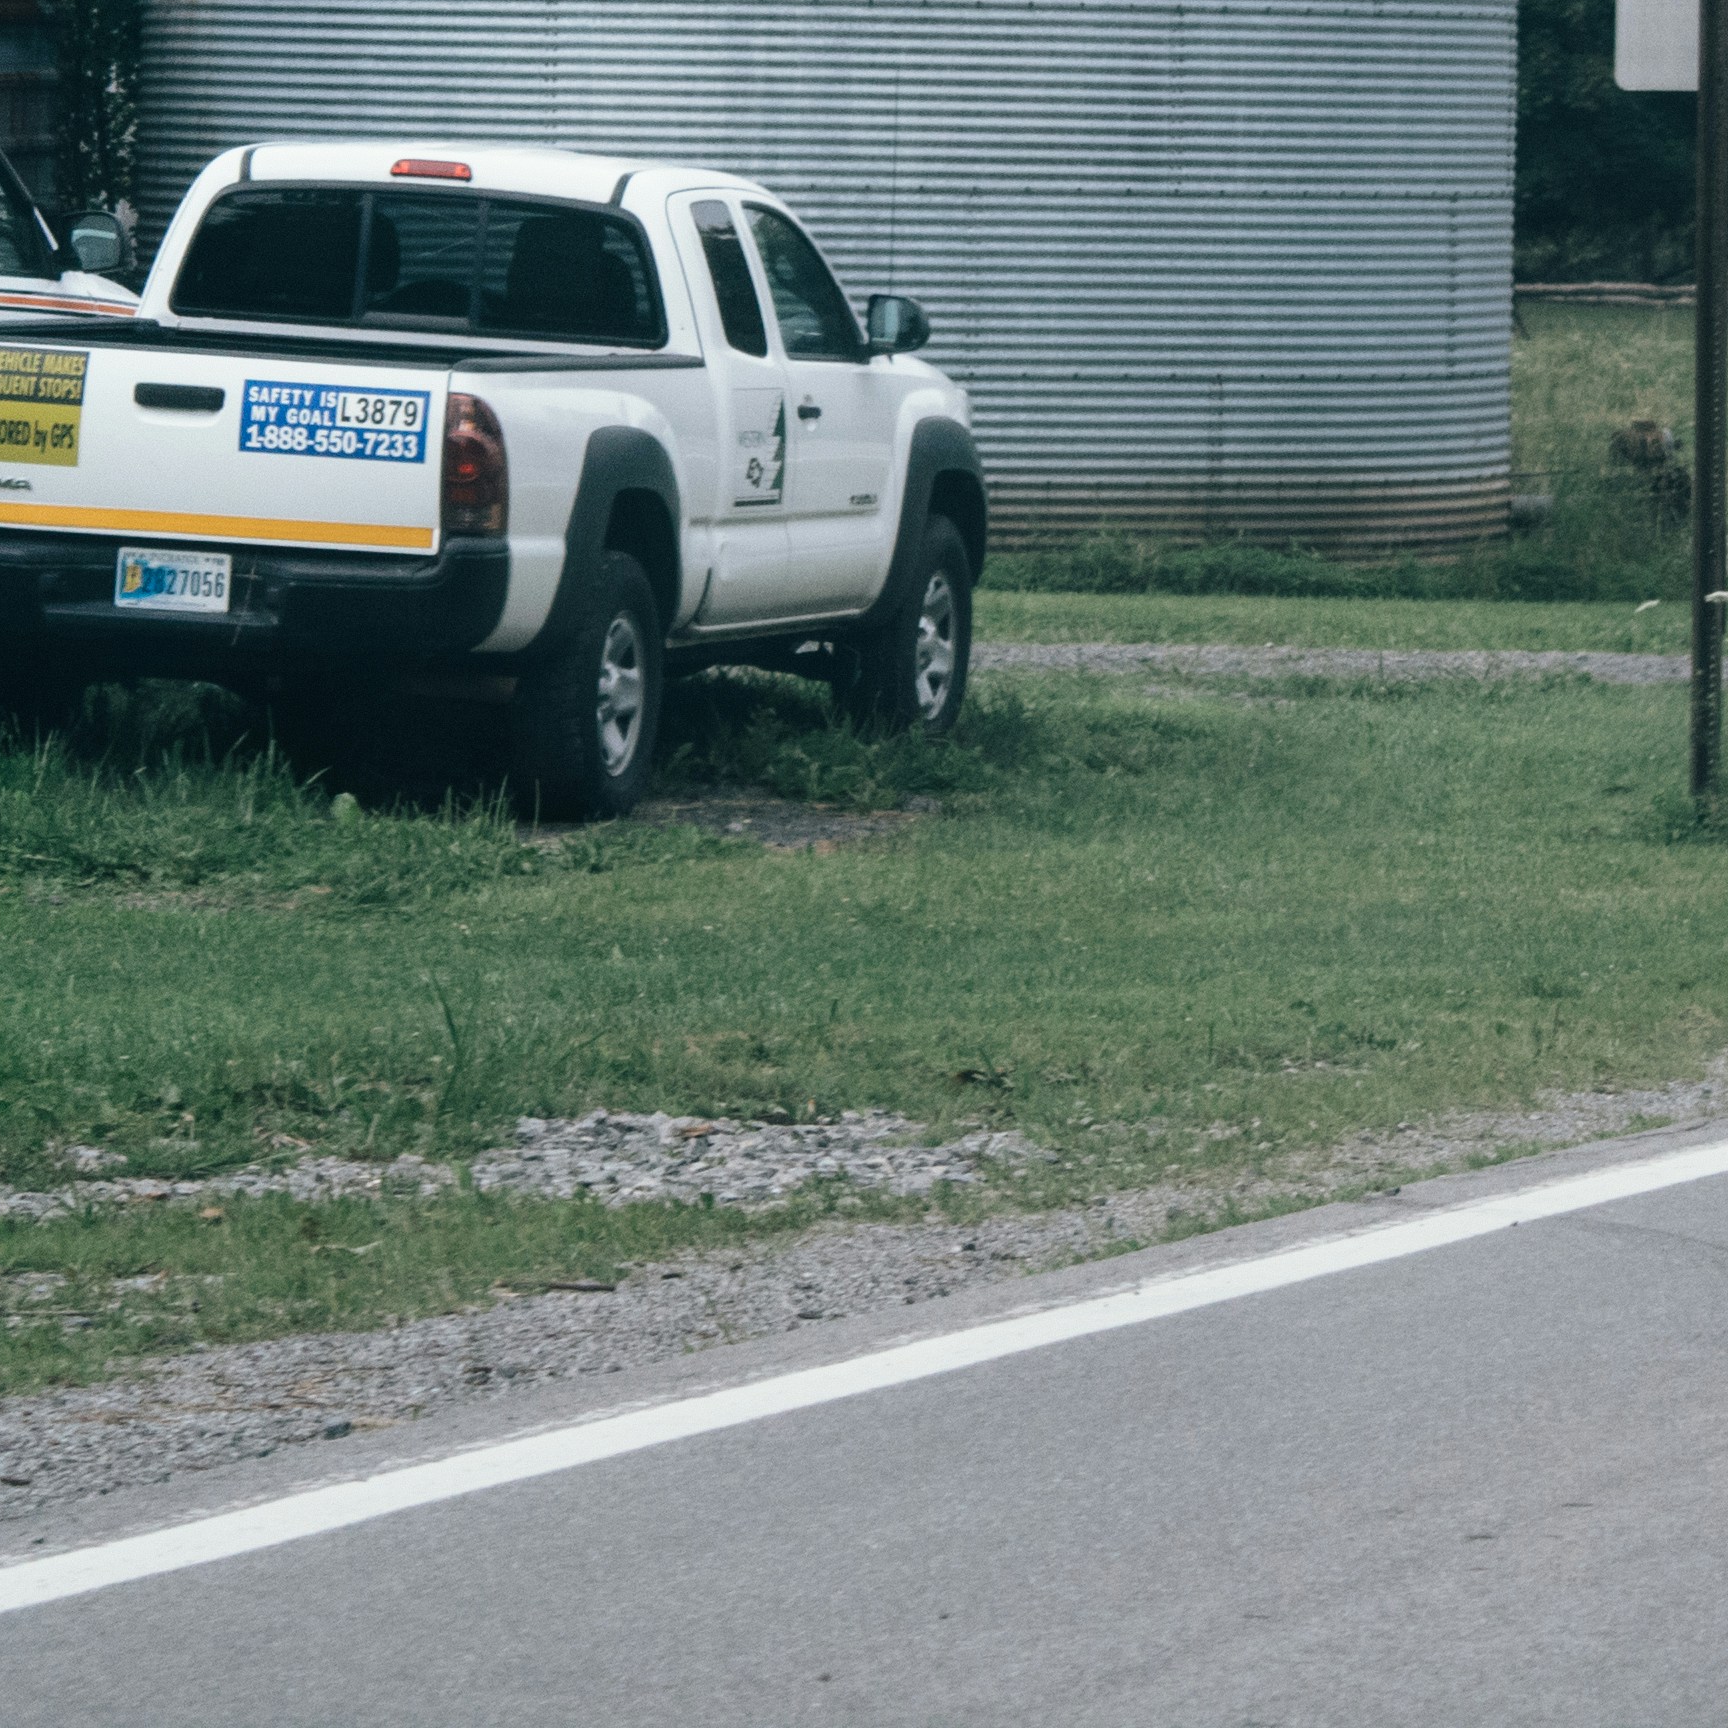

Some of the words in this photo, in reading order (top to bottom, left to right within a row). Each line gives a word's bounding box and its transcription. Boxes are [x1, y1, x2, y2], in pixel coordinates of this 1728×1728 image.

[42, 354, 86, 375] MAKES
[38, 376, 83, 399] STOPS!
[249, 386, 315, 407] SAFETY
[320, 392, 338, 408] IS
[250, 405, 280, 422] MY
[286, 408, 333, 426] GOAL
[341, 396, 419, 427] L3879
[33, 420, 48, 454] by
[51, 423, 75, 449] GPS
[245, 424, 419, 458] 1-888-550-7233
[141, 566, 225, 598] 2827056
